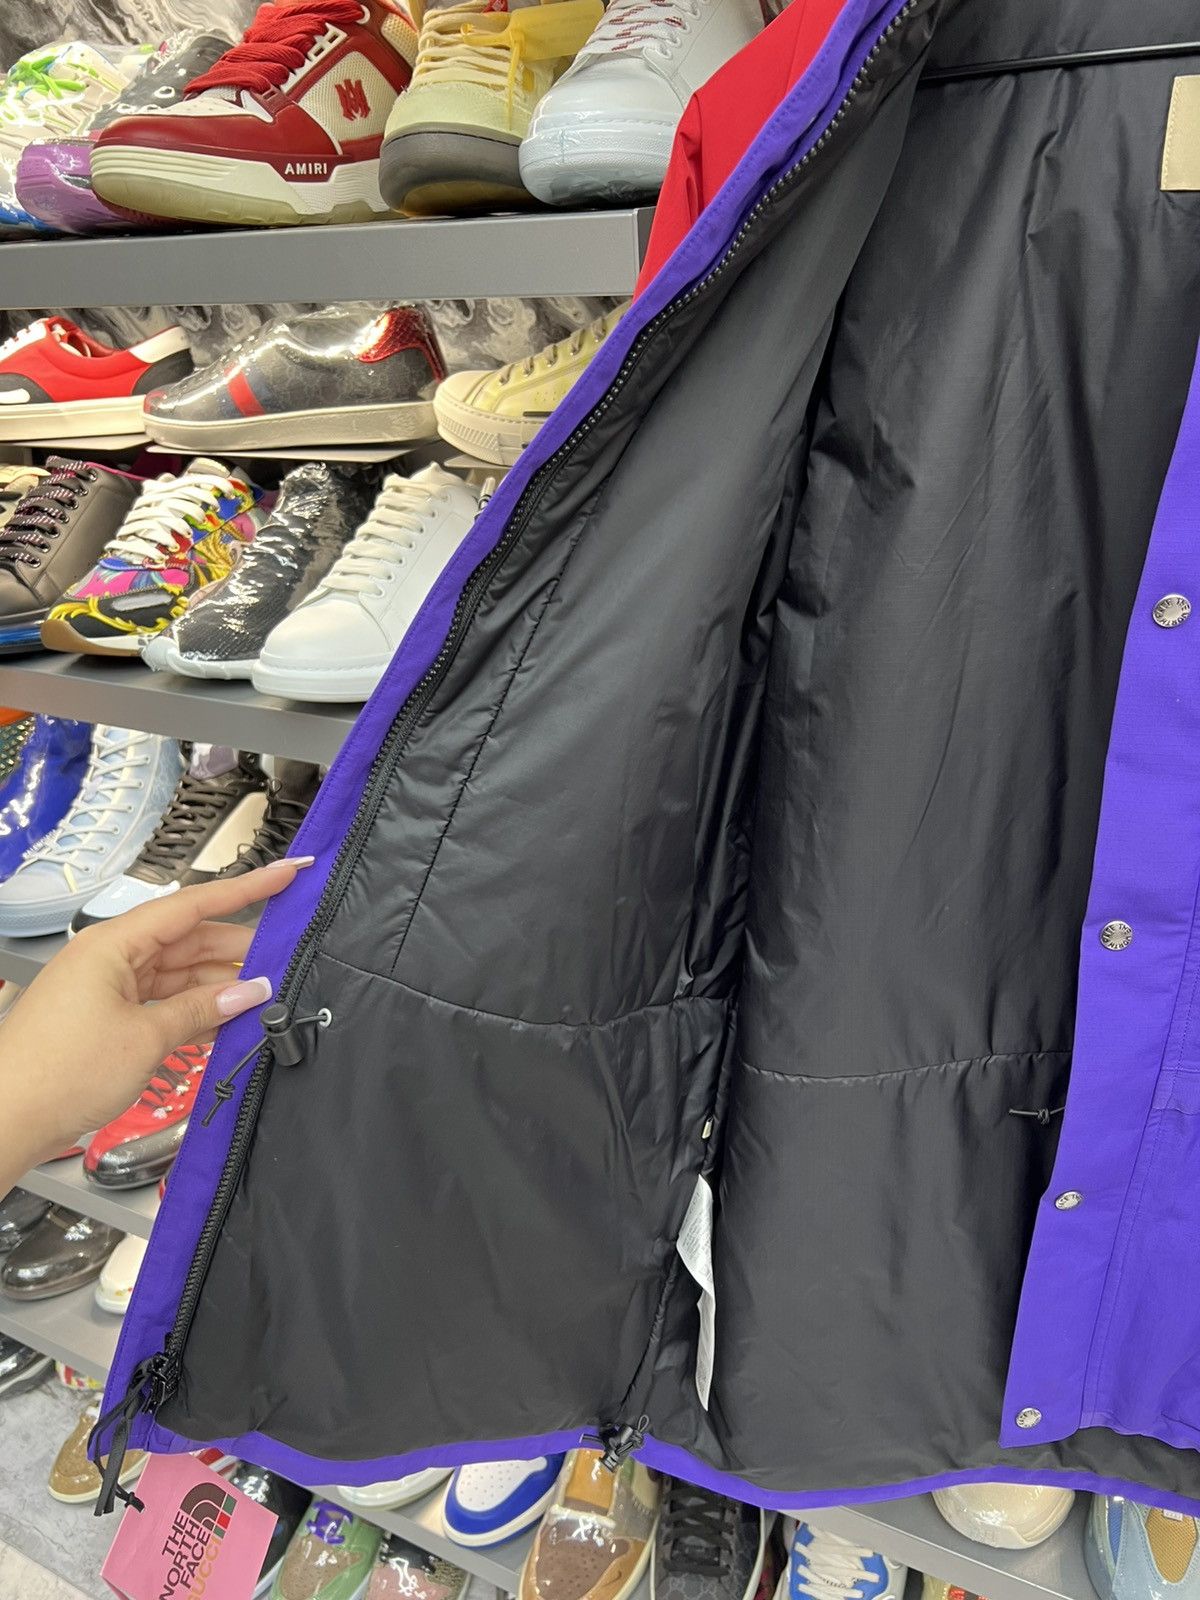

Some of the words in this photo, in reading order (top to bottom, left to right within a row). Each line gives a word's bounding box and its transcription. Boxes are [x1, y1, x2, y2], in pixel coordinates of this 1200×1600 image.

[284, 162, 328, 175] AMIRI
[159, 1519, 200, 1600] NORTH
[161, 1511, 189, 1556] THE
[180, 1527, 211, 1589] FACE
